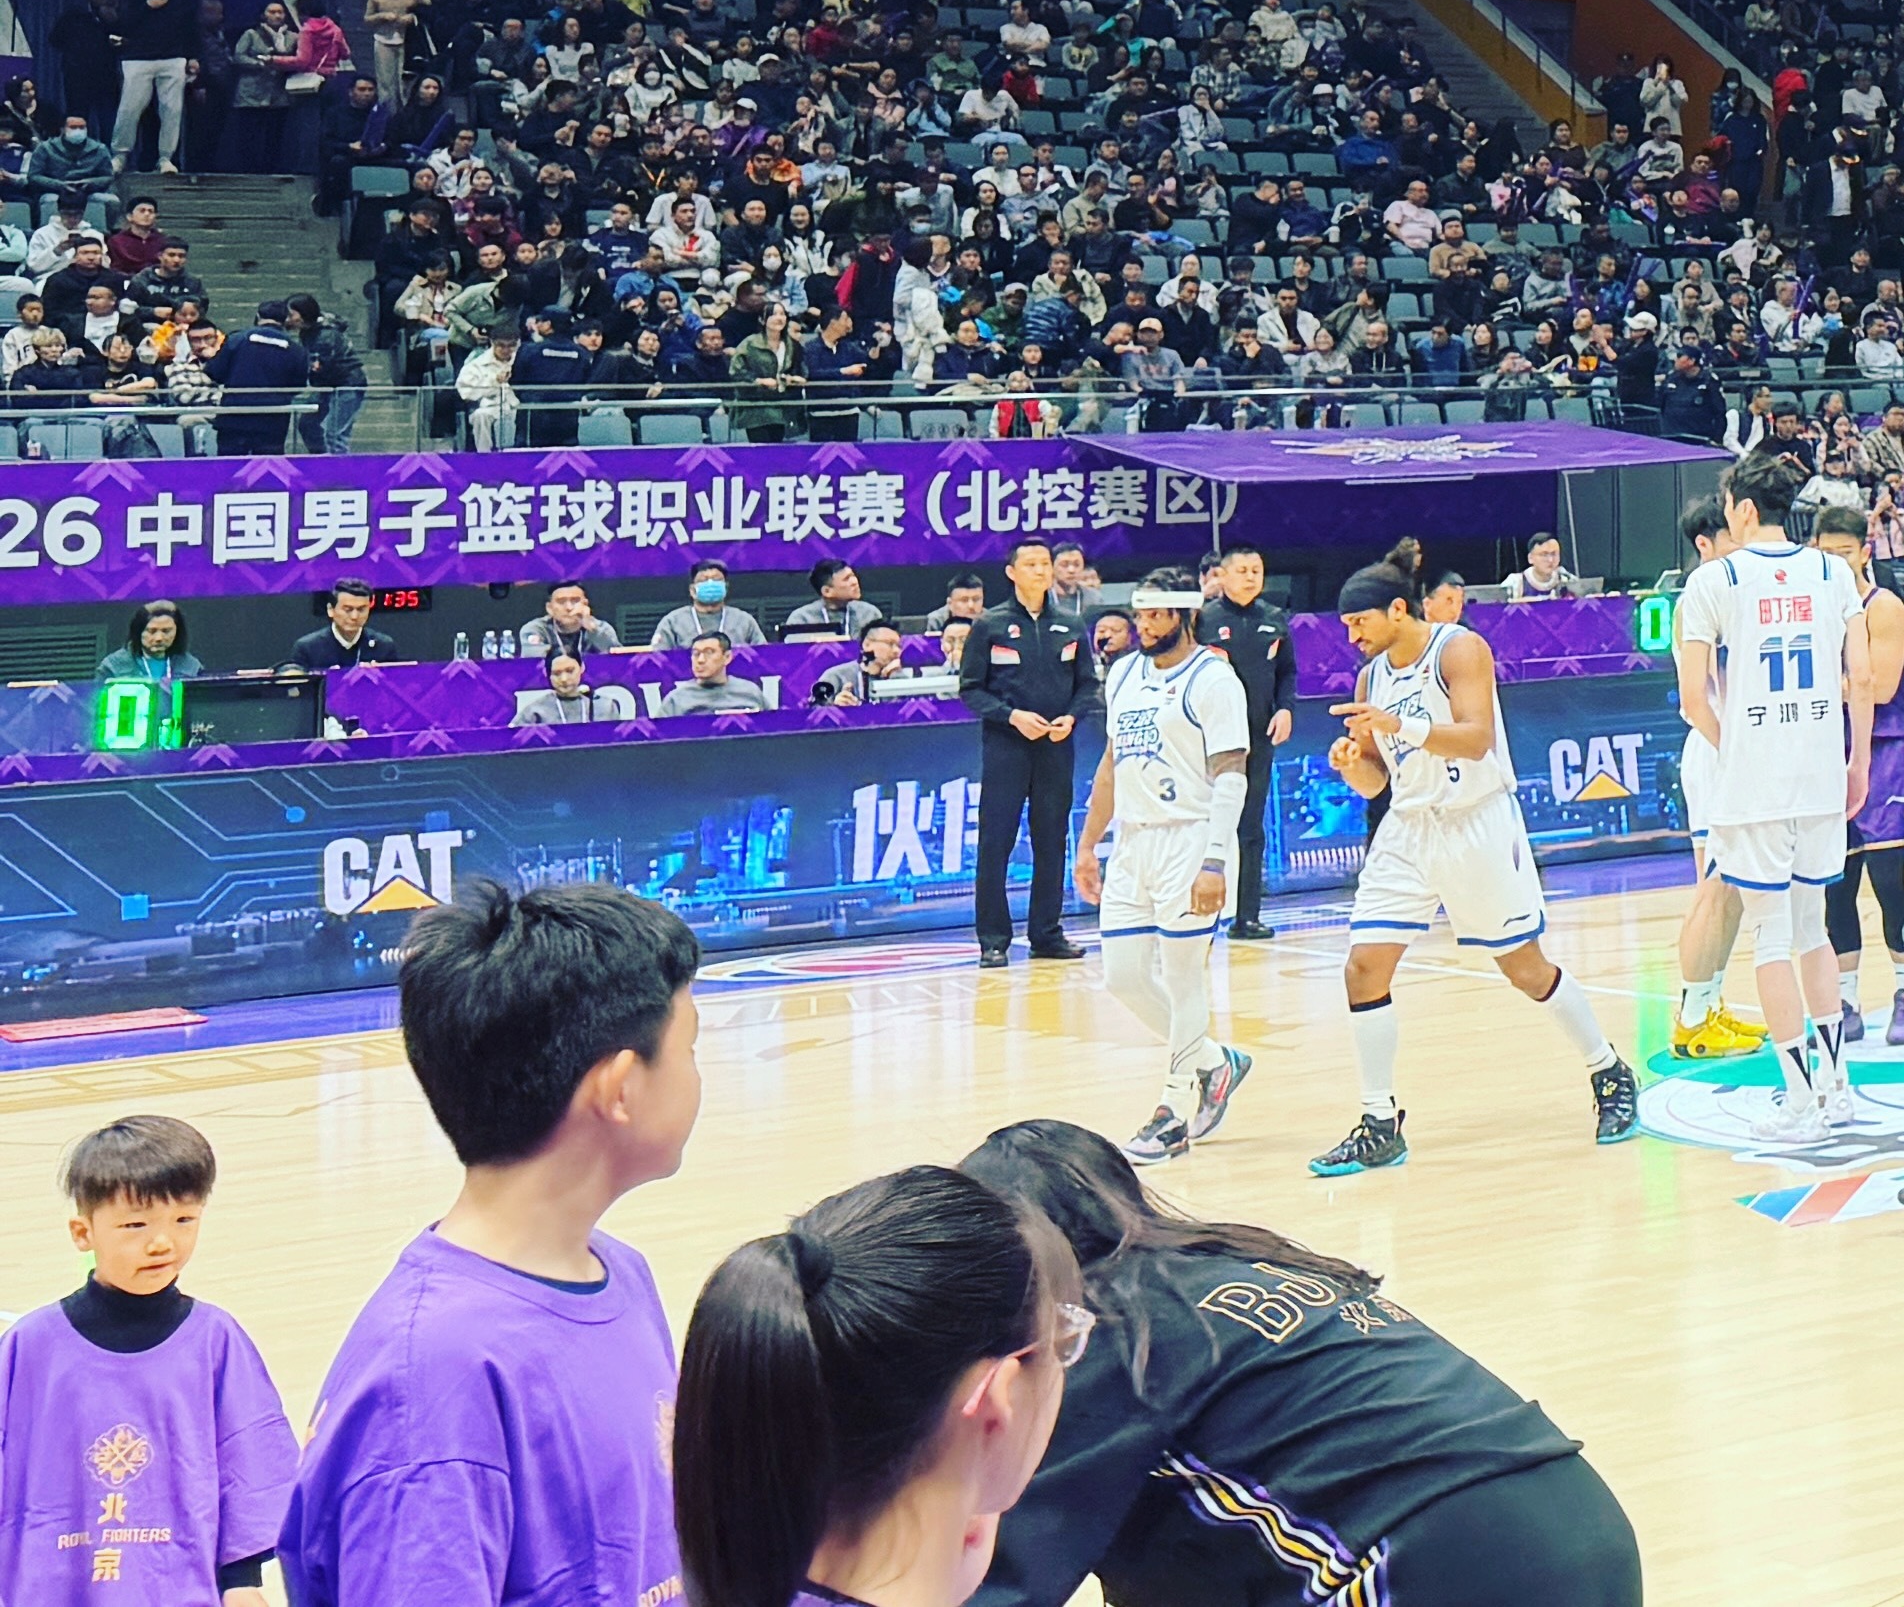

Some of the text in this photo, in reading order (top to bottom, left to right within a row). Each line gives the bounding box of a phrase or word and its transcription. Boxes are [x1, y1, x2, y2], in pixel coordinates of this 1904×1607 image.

[0, 500, 103, 569] 26
[126, 474, 904, 568] 中国男子篮球职业联赛
[1758, 595, 1813, 625] 町渥
[1759, 634, 1814, 692] 11
[1159, 777, 1177, 802] 3
[1550, 732, 1645, 802] CAT
[325, 829, 465, 916] CAT
[57, 1531, 93, 1550] ROL
